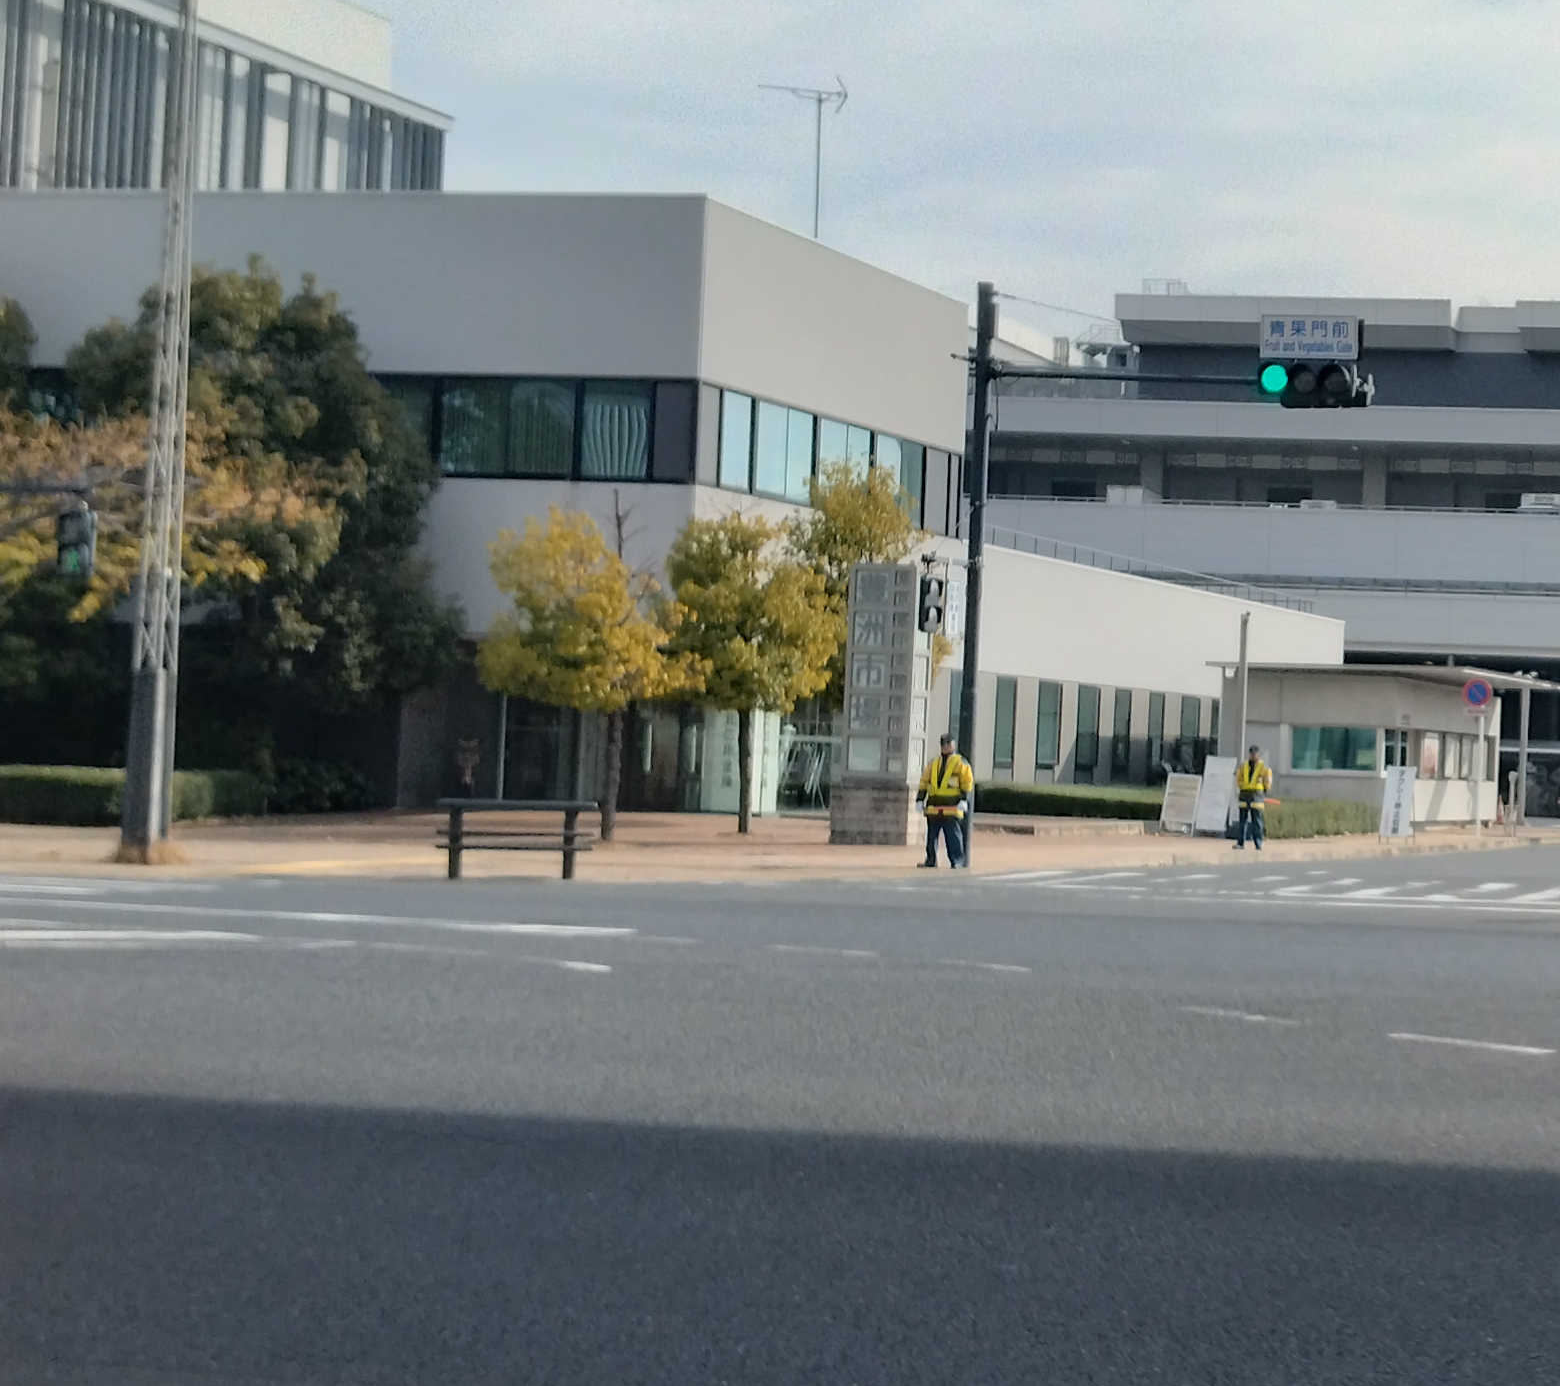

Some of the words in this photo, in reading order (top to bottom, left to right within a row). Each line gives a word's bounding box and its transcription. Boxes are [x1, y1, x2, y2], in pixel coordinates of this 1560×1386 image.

[1269, 320, 1349, 338] 青果門前
[1282, 340, 1295, 352] and
